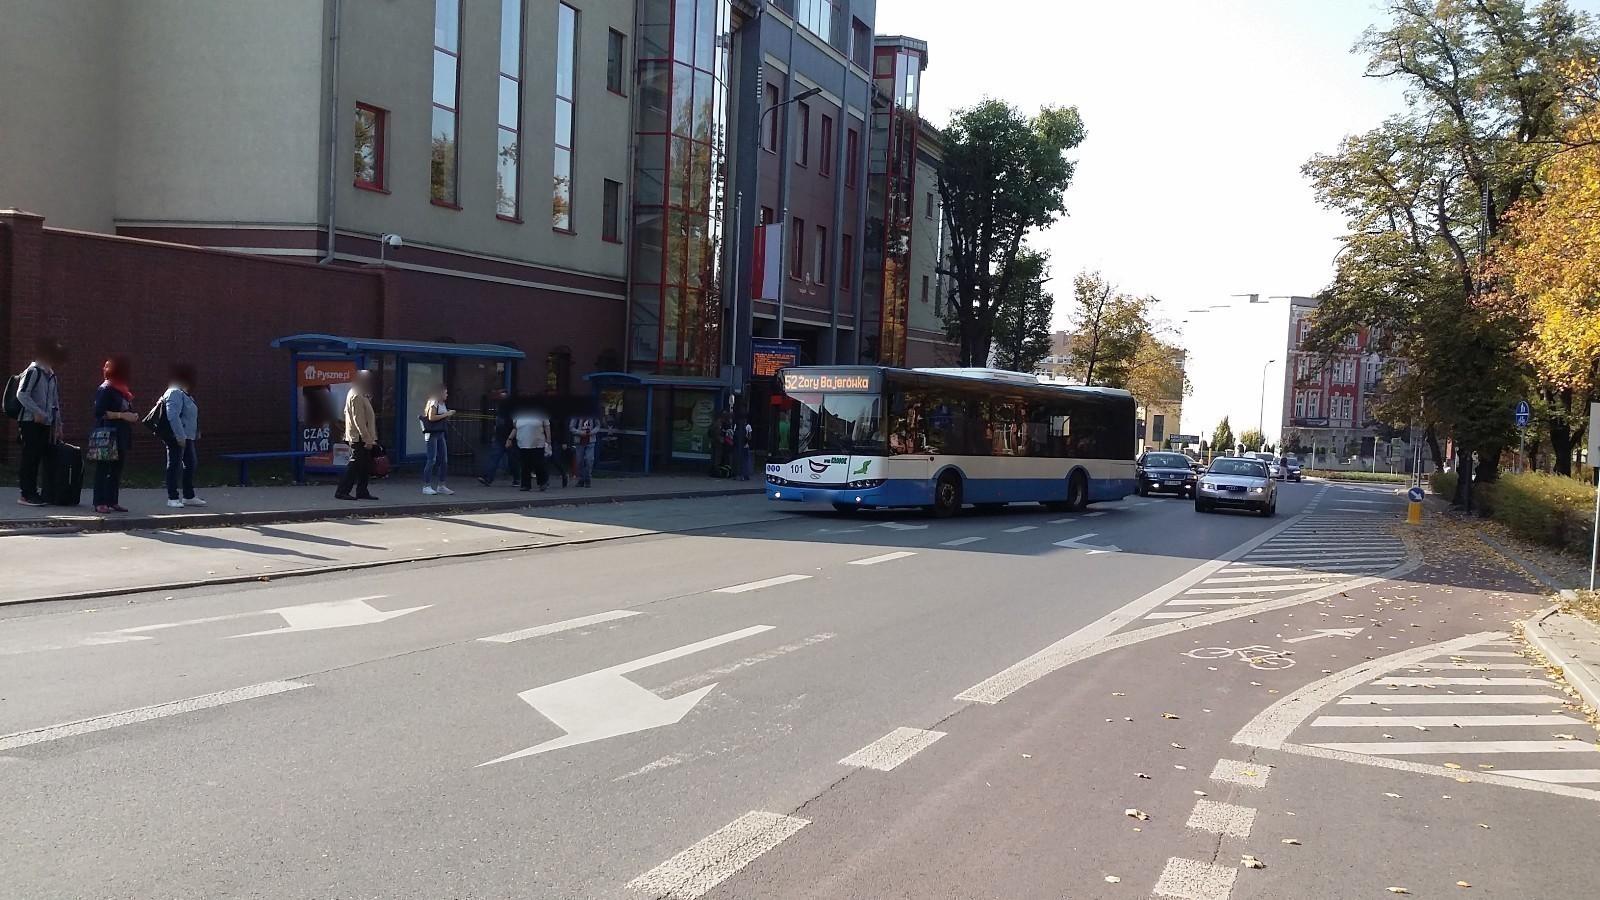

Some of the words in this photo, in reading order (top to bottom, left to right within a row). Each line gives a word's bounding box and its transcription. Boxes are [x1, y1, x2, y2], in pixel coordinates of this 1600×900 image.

[317, 370, 349, 380] Pyszne.pl
[303, 441, 318, 452] NA
[791, 464, 803, 474] 101
